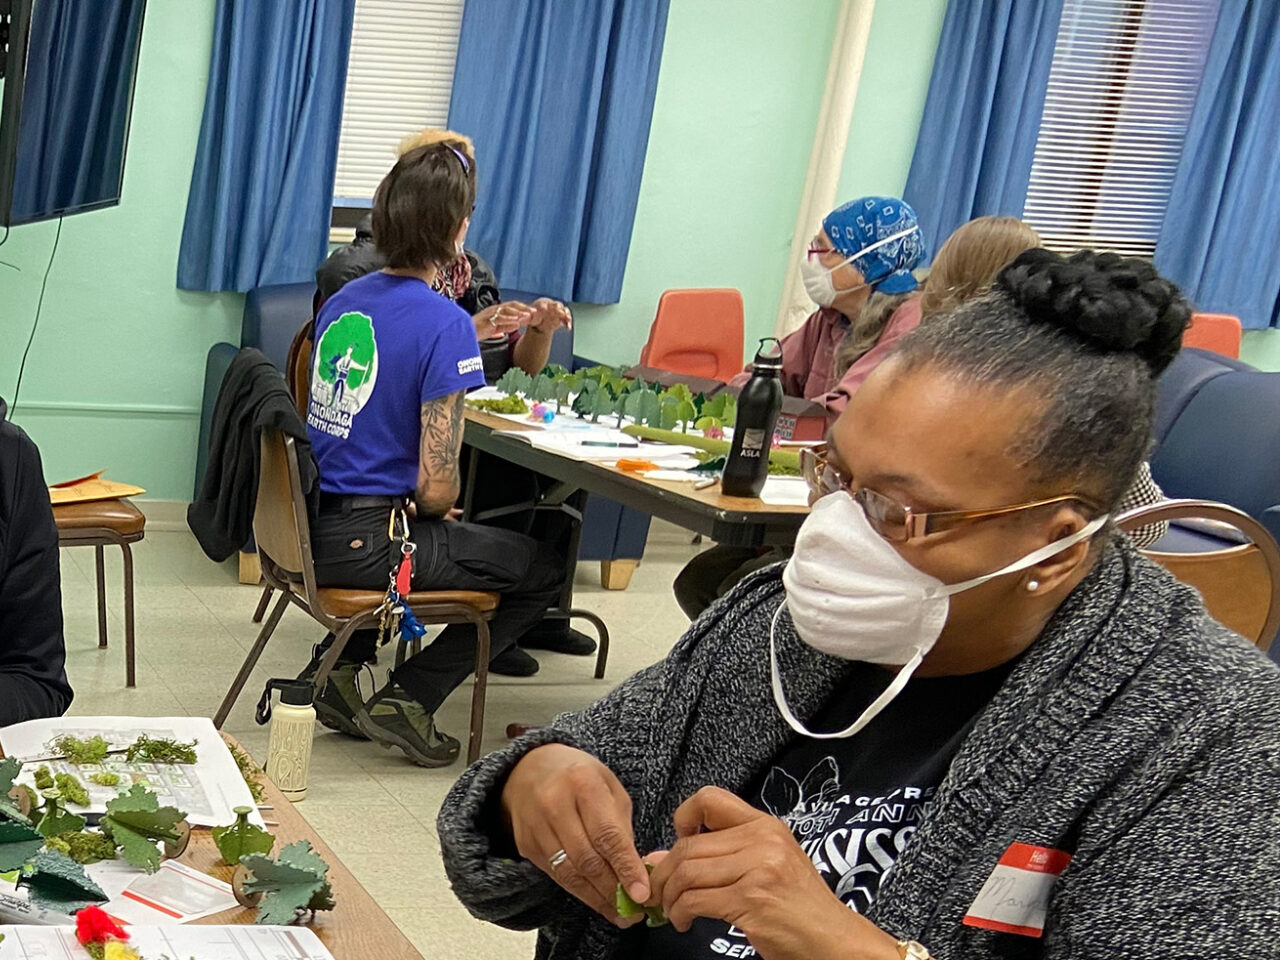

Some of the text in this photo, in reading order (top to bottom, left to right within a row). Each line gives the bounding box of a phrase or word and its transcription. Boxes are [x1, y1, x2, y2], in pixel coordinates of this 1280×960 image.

[307, 413, 350, 440] EARTH CORPS
[310, 401, 353, 428] ONONDAGA
[740, 449, 760, 458] ASLA
